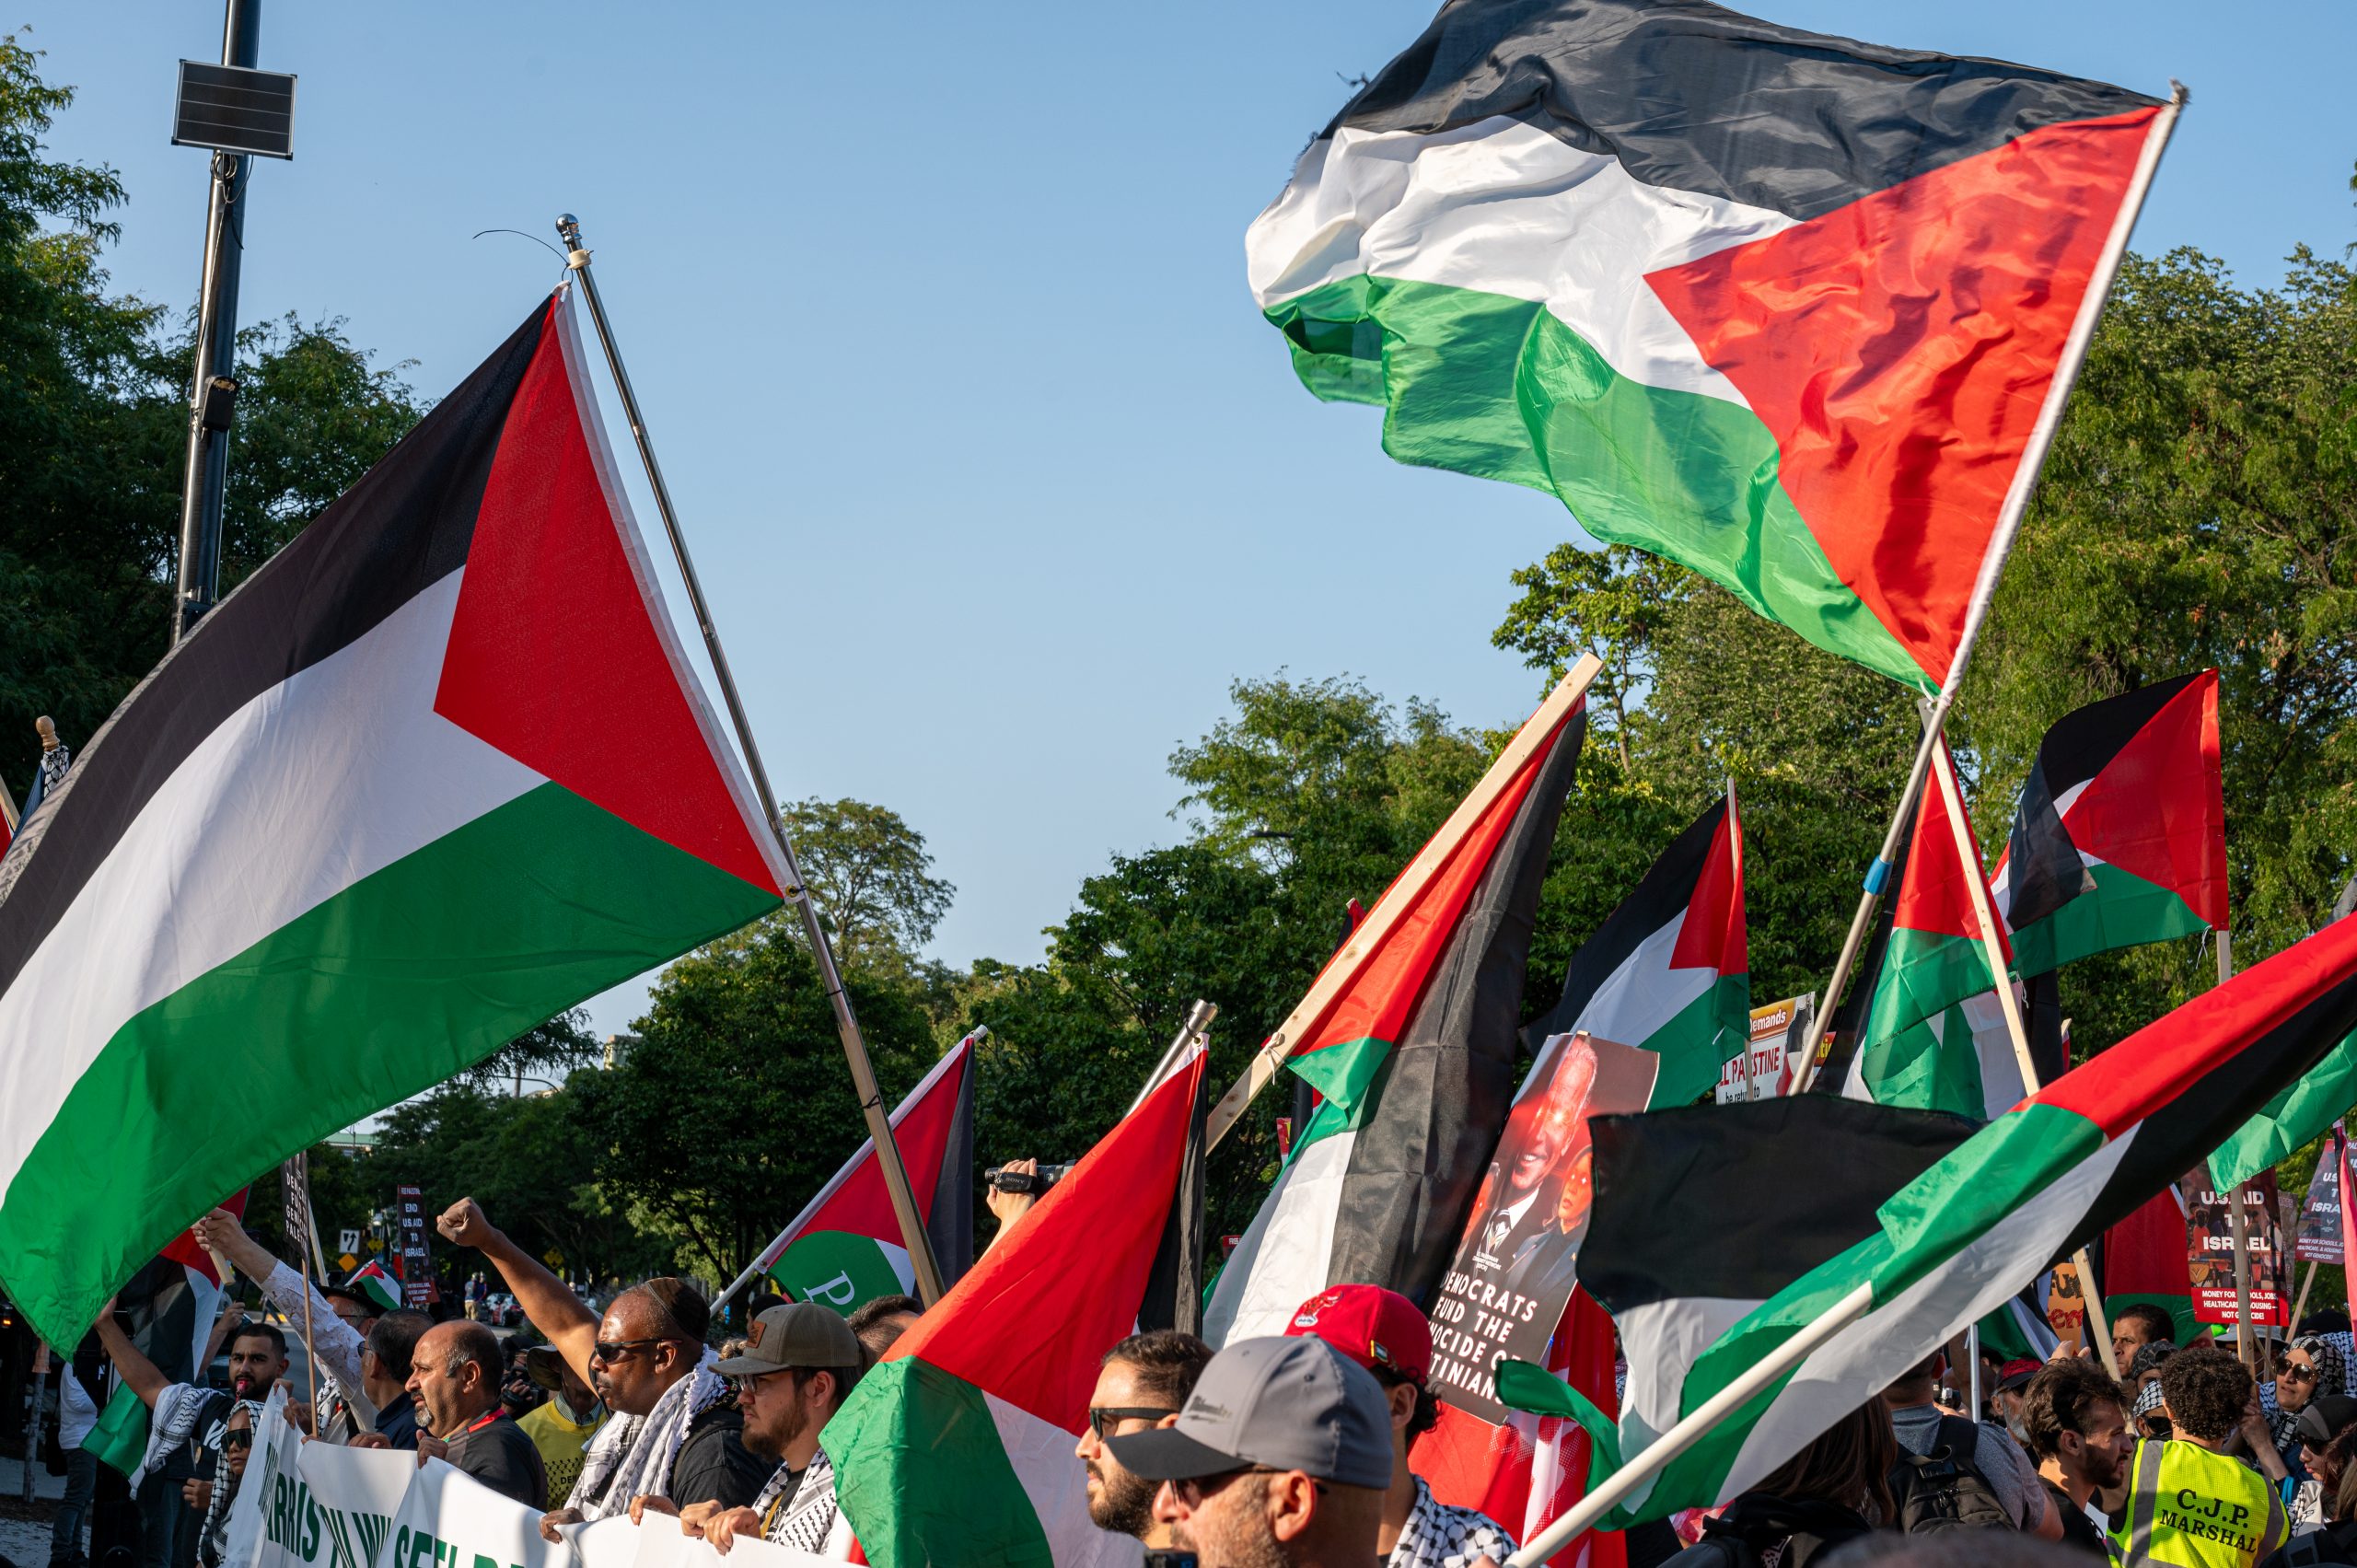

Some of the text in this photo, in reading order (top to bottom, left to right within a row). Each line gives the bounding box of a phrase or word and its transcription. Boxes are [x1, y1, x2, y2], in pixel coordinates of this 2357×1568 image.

[1732, 1047, 1780, 1085] PASTINE
[1754, 1084, 1760, 1098] to
[2323, 1172, 2338, 1182] U.S
[2331, 1189, 2339, 1198] T
[405, 1202, 418, 1213] END
[2311, 1202, 2341, 1214] ISRA
[410, 1233, 419, 1242] TO
[2202, 1236, 2270, 1251] ISREL
[405, 1248, 426, 1257] ISRAEL
[1433, 1295, 1515, 1343] FUND THE
[1429, 1320, 1487, 1364] NOCIDE
[2177, 1488, 2249, 1528] C.J.P.
[2159, 1509, 2258, 1553] MARSHAL
